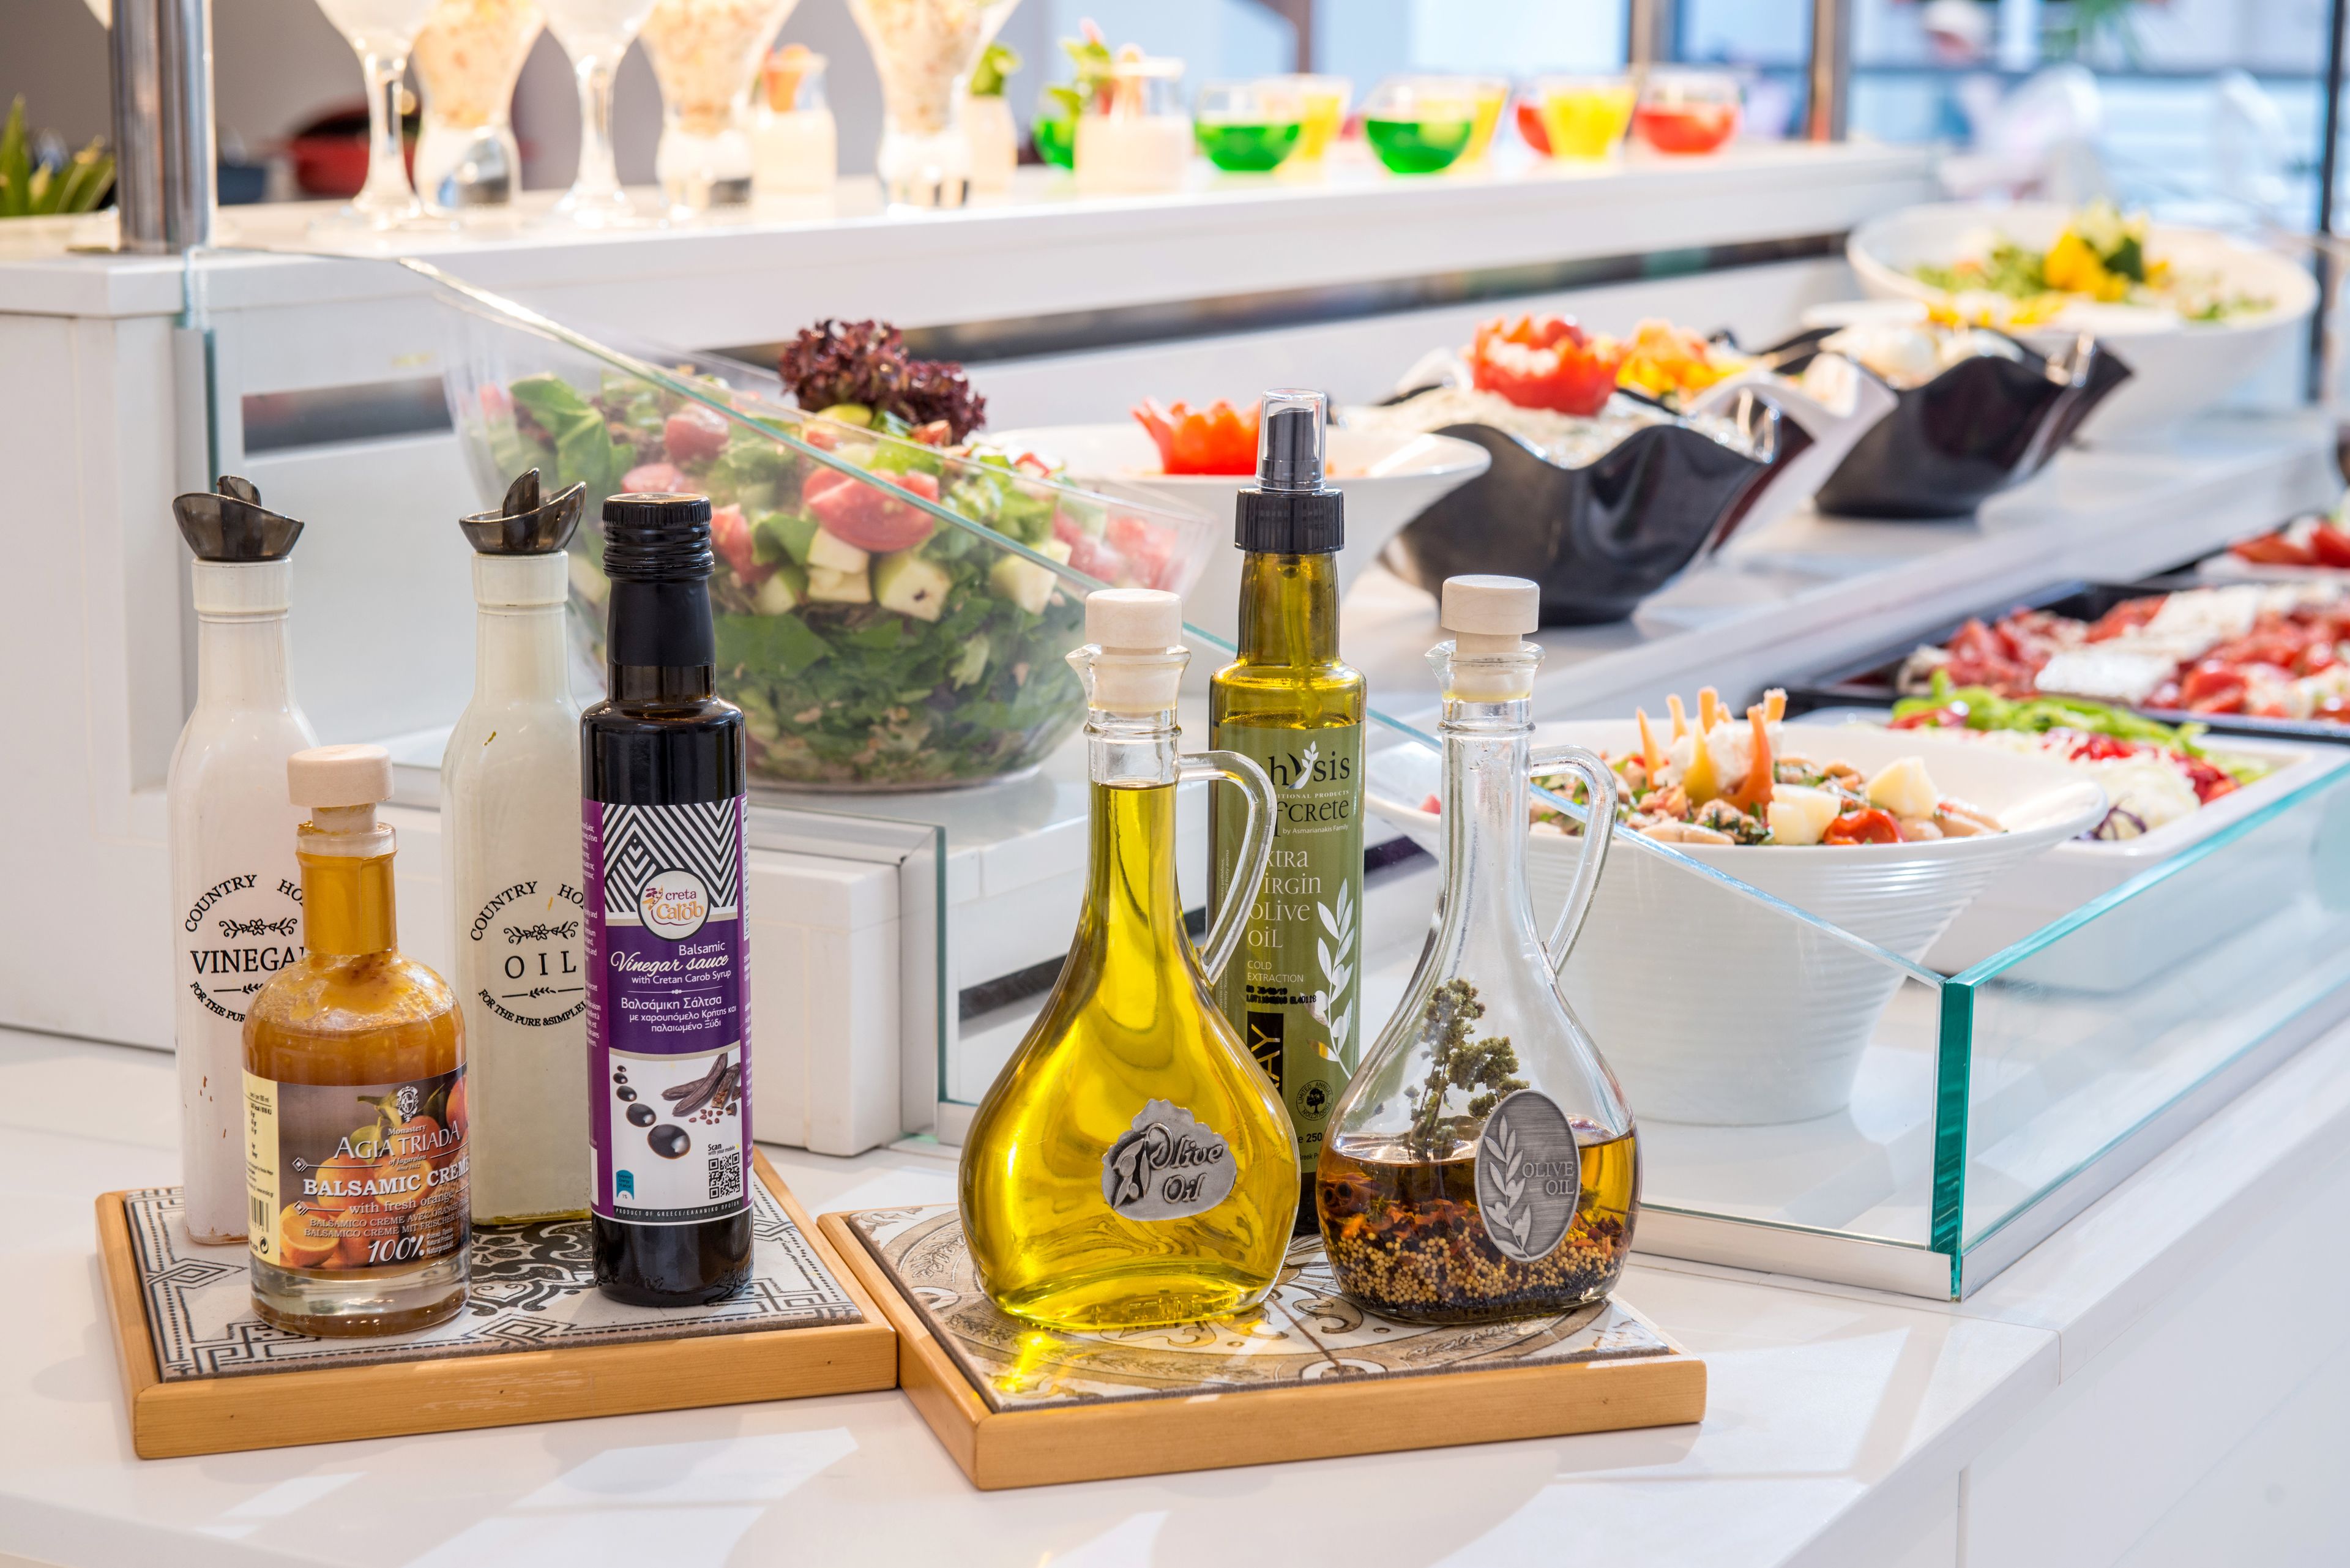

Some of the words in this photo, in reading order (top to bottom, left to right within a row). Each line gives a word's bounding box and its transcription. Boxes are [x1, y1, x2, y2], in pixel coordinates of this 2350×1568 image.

[1264, 749, 1350, 789] hysis
[1315, 790, 1349, 798] PRODUCTS
[1334, 823, 1349, 832] Family
[185, 875, 257, 932] COUNTRY
[277, 879, 303, 906] HO
[665, 889, 696, 900] creta
[471, 881, 537, 941] COUNTRY
[558, 884, 584, 909] HO
[679, 941, 725, 956] Balsamic
[190, 947, 304, 974] VINEGA
[610, 951, 683, 977] Vinegar
[685, 955, 729, 970] sauce
[1248, 960, 1272, 970] COLD
[632, 976, 651, 984] with
[652, 976, 682, 984] Cretan
[685, 973, 711, 983] Carob
[712, 969, 731, 980] Syrup
[1248, 973, 1304, 983] EXTRACTION
[190, 982, 207, 1002] FOR
[204, 998, 226, 1017] THE
[226, 1010, 245, 1022] PUR
[478, 989, 495, 1009] FOR
[494, 1004, 514, 1021] THE
[515, 1015, 540, 1026] PURE
[621, 997, 679, 1013] Βαλσάμικη
[683, 996, 722, 1009] Σάλτσα
[629, 1014, 639, 1023] με
[641, 1012, 699, 1025] χαρουπόμελο
[701, 1007, 726, 1020] Κρήτης
[728, 1005, 737, 1014] και
[651, 1021, 703, 1033] παλαιωμένο
[704, 1018, 721, 1029] Ξύδι
[1251, 1023, 1281, 1088] AY
[1298, 1084, 1312, 1104] LIMITED
[1316, 1082, 1332, 1097] ANNUAL
[1302, 1102, 1331, 1119] PRODUCTION
[388, 1125, 427, 1136] Monastery
[1306, 1132, 1322, 1143] 250
[334, 1137, 395, 1160] AGIA
[398, 1121, 460, 1155] TRIADA
[1146, 1122, 1224, 1171] Olive
[389, 1158, 397, 1167] of
[1522, 1162, 1574, 1179] OLIVE
[304, 1174, 421, 1197] BALSAMIC
[1163, 1173, 1207, 1204] Oil
[1545, 1180, 1576, 1195] OIL
[349, 1202, 379, 1214] with
[384, 1198, 416, 1212] fresh
[420, 1190, 454, 1207] orange
[310, 1219, 367, 1228] BALSAMICO
[408, 1212, 431, 1222] AVEC
[433, 1203, 459, 1217] ORANGE
[616, 1208, 641, 1216] PRODUCT
[304, 1228, 362, 1238] BALSAMICO
[401, 1225, 417, 1234] MIT
[420, 1214, 455, 1230] FRISCHER
[441, 1233, 453, 1242] Product
[368, 1234, 425, 1264] 100%
